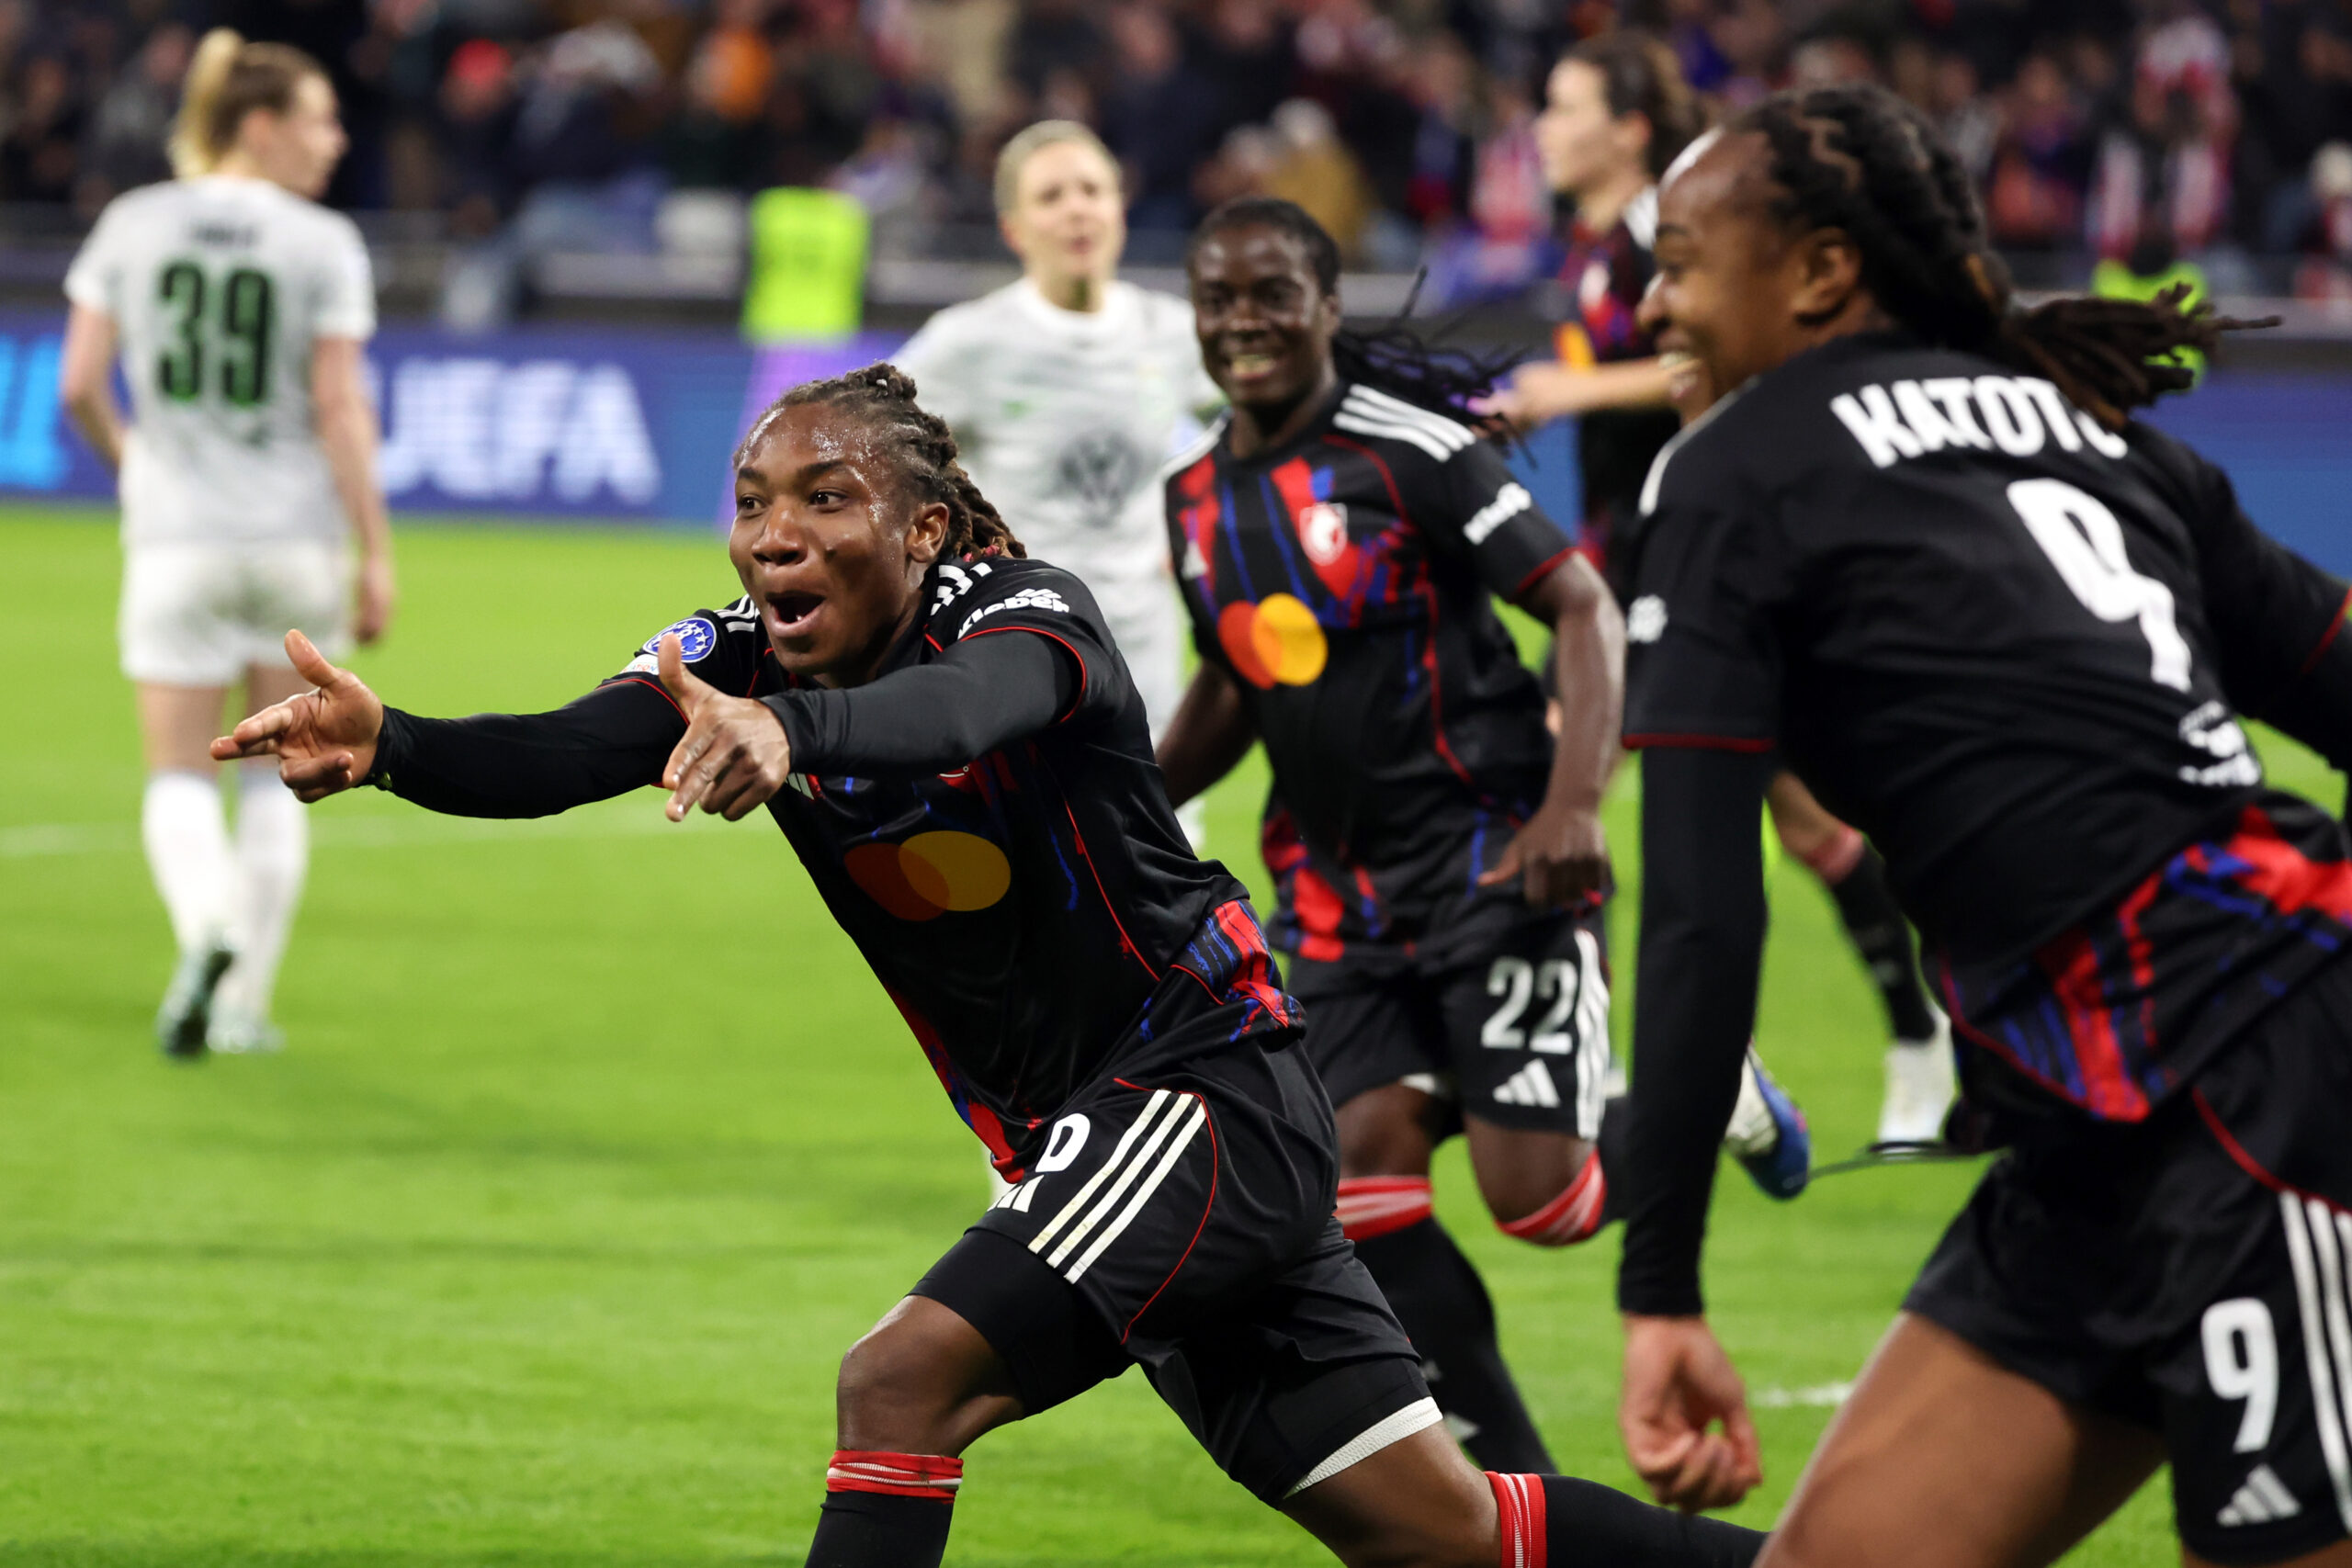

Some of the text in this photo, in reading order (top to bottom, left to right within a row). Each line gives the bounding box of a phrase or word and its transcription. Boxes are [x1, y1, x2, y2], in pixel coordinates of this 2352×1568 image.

[158, 258, 274, 404] 39
[2007, 478, 2193, 693] 9
[1480, 955, 1578, 1055] 22
[2200, 1297, 2279, 1454] 9
